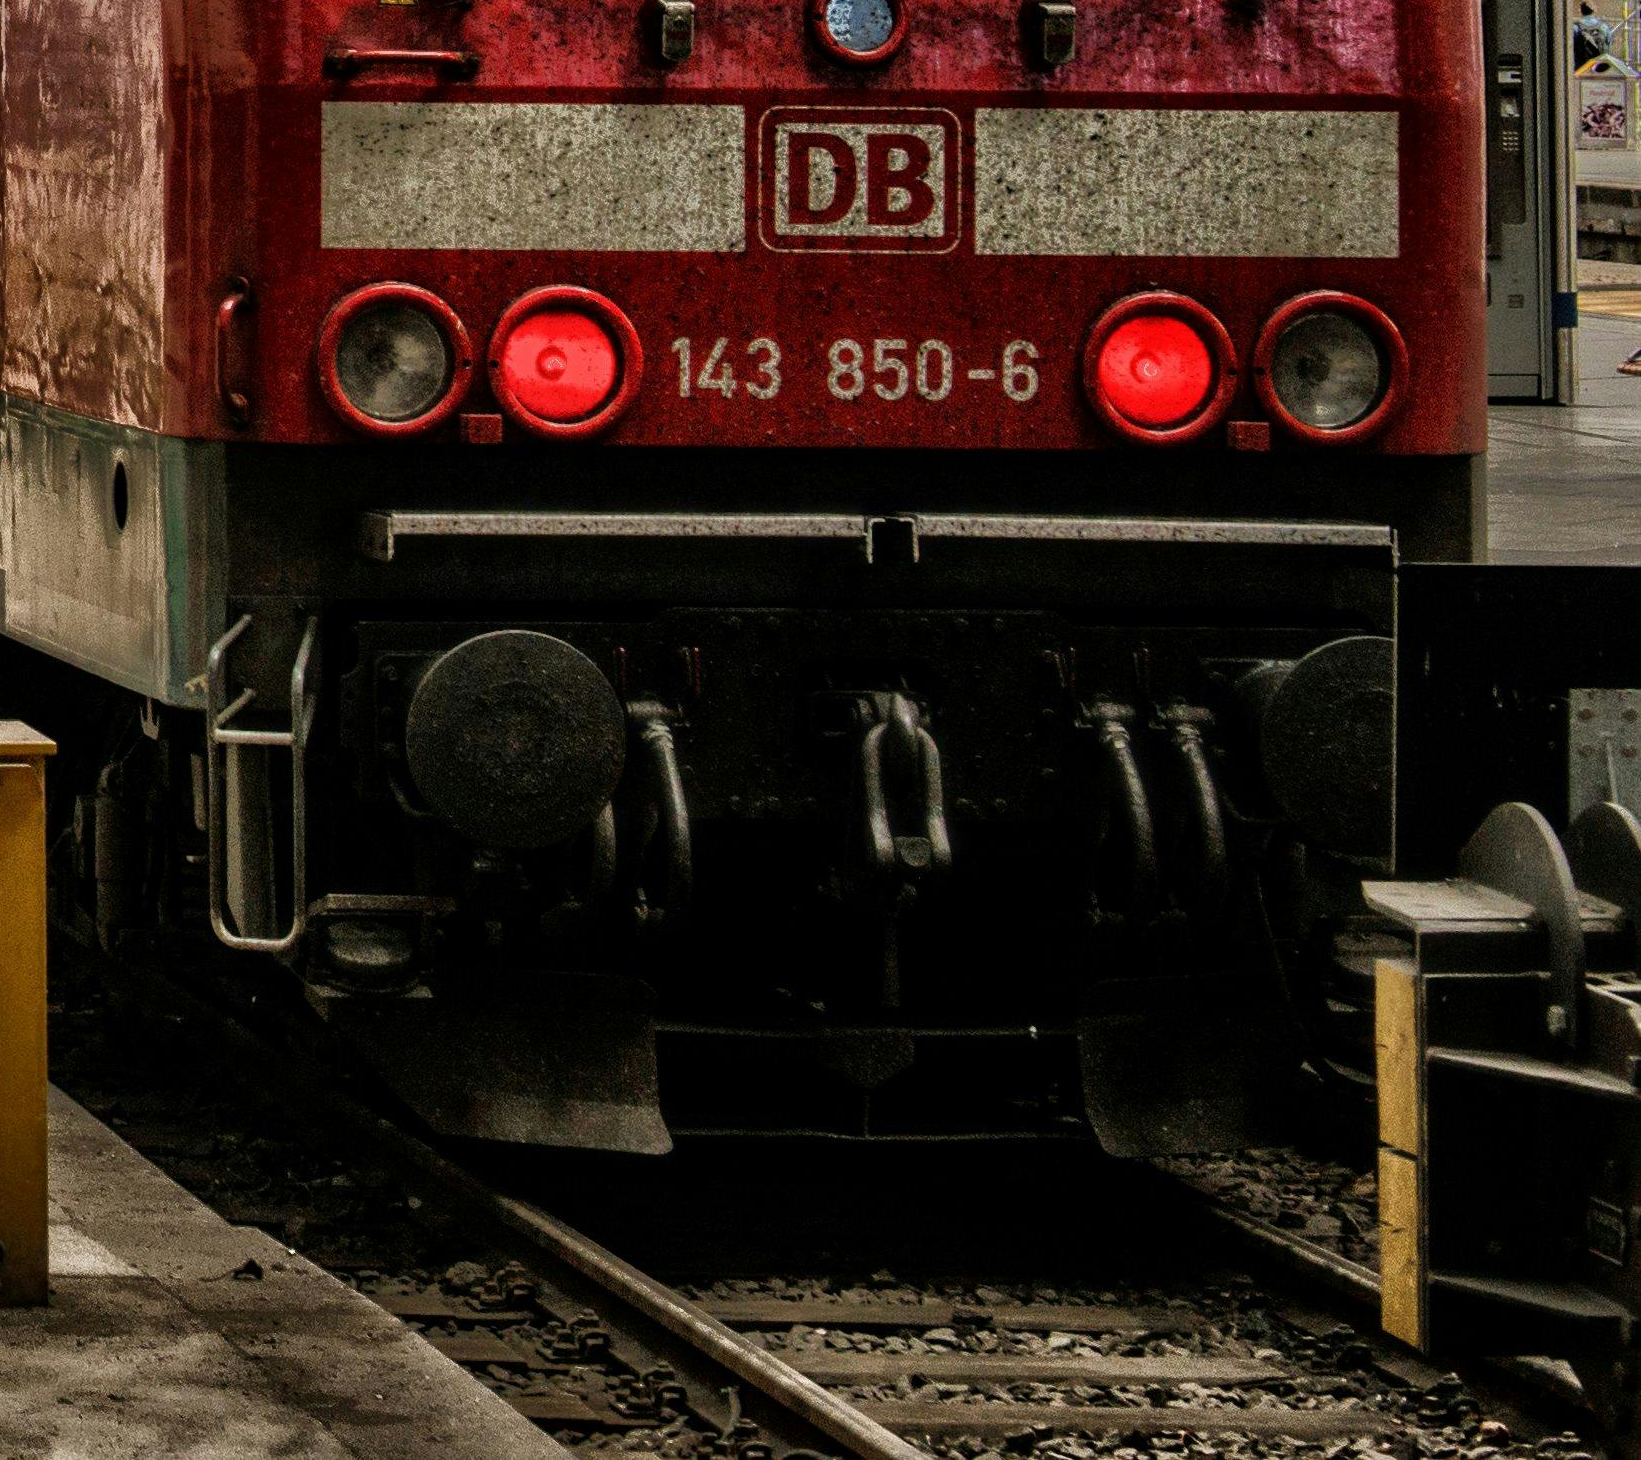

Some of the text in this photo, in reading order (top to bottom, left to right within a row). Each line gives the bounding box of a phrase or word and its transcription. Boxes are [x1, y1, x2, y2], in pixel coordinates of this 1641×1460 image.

[788, 132, 935, 226] DB
[672, 337, 1039, 402] 143 850-6
